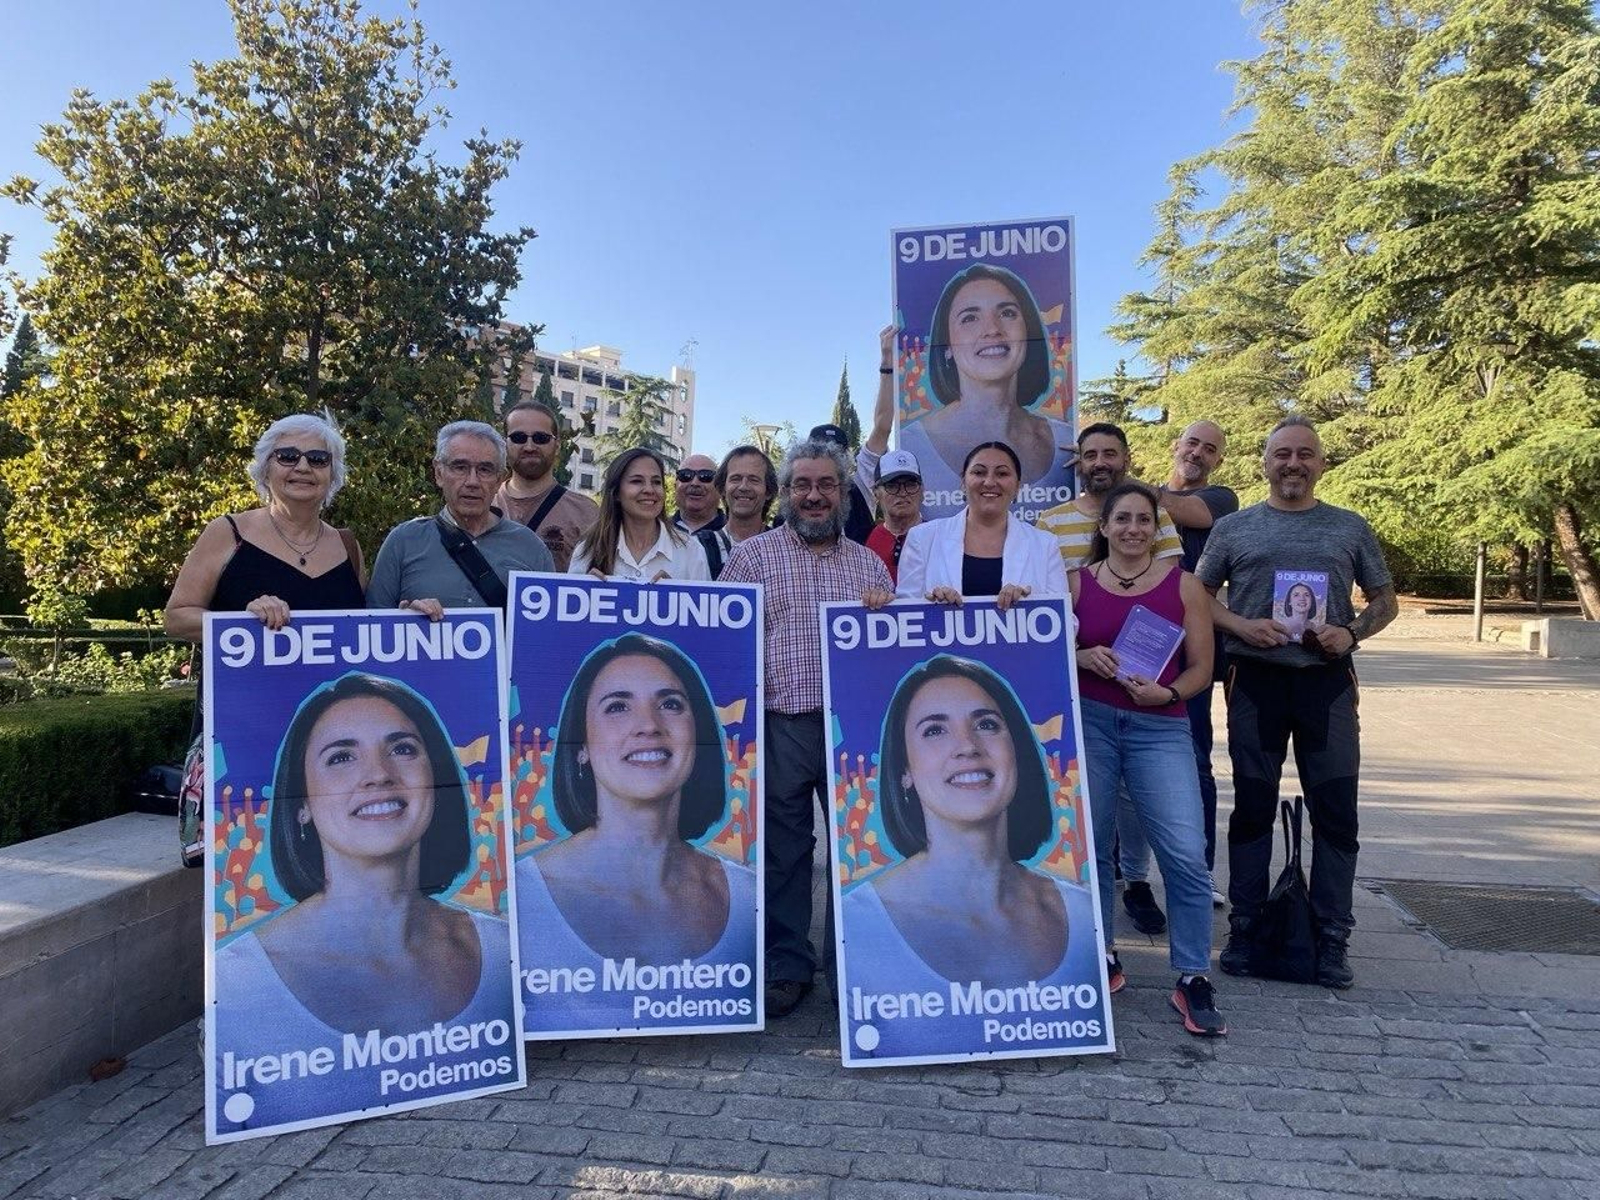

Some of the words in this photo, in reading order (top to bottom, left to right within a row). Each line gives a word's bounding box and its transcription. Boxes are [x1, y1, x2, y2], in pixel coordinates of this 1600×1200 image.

[900, 236, 919, 263] 9
[924, 232, 967, 261] DE
[969, 225, 1067, 258] JUNIO
[922, 488, 964, 507] ene
[1276, 573, 1283, 581] 9
[1284, 573, 1297, 581] DE
[1296, 573, 1326, 582] JUNIO
[520, 585, 550, 621] 9
[557, 586, 618, 623] DE
[622, 590, 753, 629] JUNIO
[219, 627, 255, 668] 9
[263, 624, 335, 666] DE
[341, 620, 492, 664] JUNIO
[832, 614, 861, 650] 9
[866, 612, 926, 649] DE
[930, 606, 1062, 647] JUNIO
[520, 967, 596, 994] ene
[602, 957, 751, 992] Montero
[633, 995, 751, 1019] Podemos
[852, 986, 944, 1021] Irene
[949, 980, 1098, 1016] Montero
[984, 1017, 1101, 1043] Podemos
[223, 1046, 336, 1090] Irene
[342, 1019, 511, 1071] Montero
[380, 1055, 512, 1096] Podemos
